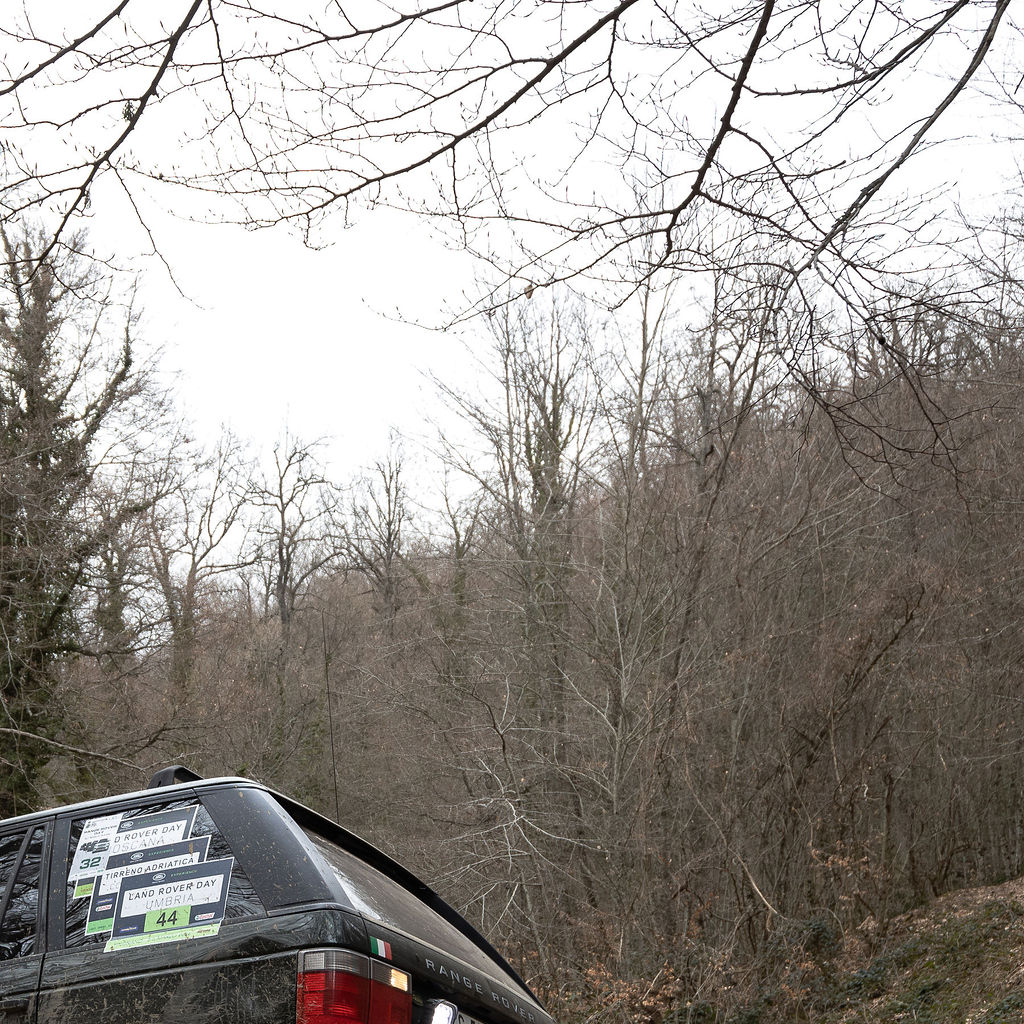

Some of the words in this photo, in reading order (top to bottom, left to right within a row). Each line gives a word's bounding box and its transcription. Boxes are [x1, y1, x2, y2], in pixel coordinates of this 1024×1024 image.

[124, 829, 158, 841] ROVER
[161, 824, 182, 833] DAY
[110, 835, 165, 854] OSCANA
[80, 857, 101, 870] 32
[106, 867, 143, 880] TIRRENO
[146, 857, 194, 872] ADRIATICA
[128, 888, 154, 901] LAND
[159, 883, 192, 896] ROVER
[197, 879, 217, 889] DAY
[146, 893, 194, 909] UMBRIA
[156, 910, 177, 927] 44
[426, 958, 483, 995] RANGE
[491, 991, 535, 1024] ROVER
